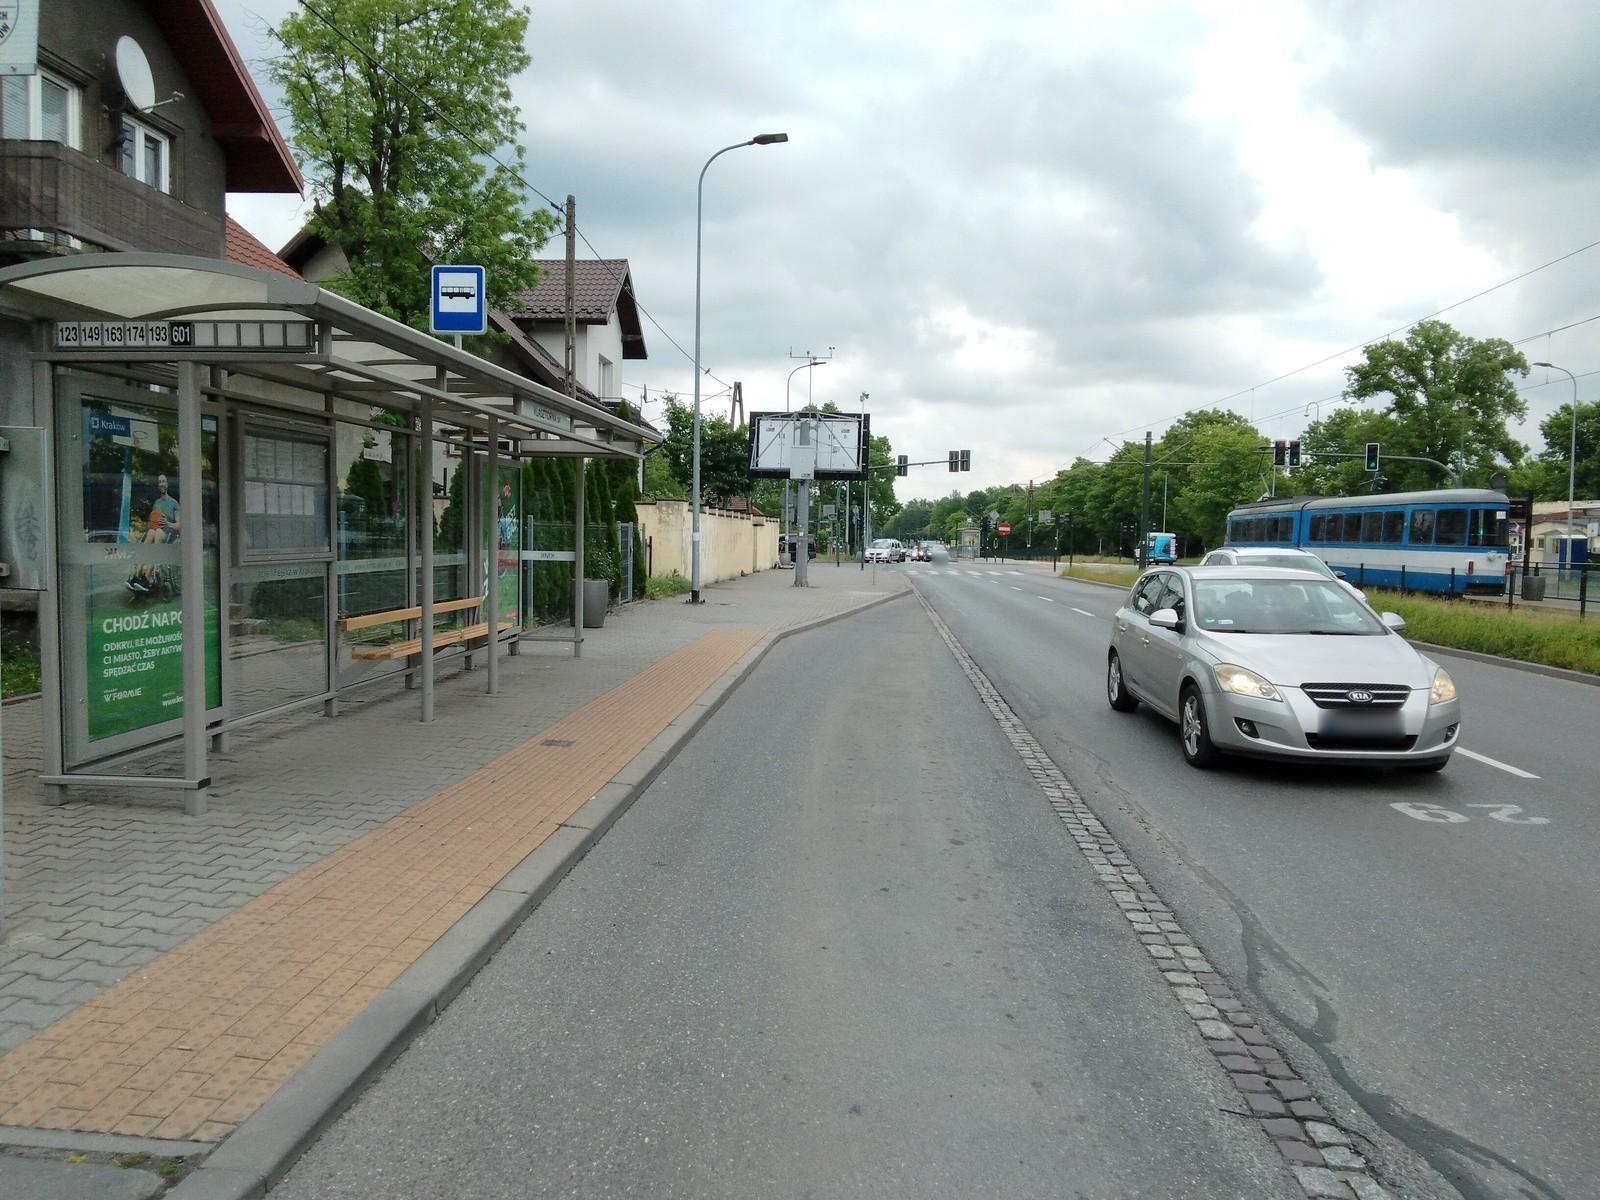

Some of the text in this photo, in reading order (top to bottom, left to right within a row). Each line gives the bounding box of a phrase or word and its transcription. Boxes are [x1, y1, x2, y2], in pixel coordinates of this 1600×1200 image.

[59, 326, 190, 342] 123 149 163 174 193 601
[103, 610, 149, 634] CHODŹ
[152, 612, 170, 628] NA
[103, 656, 112, 664] CI
[137, 661, 155, 671] CZAS
[1352, 692, 1369, 700] KIA
